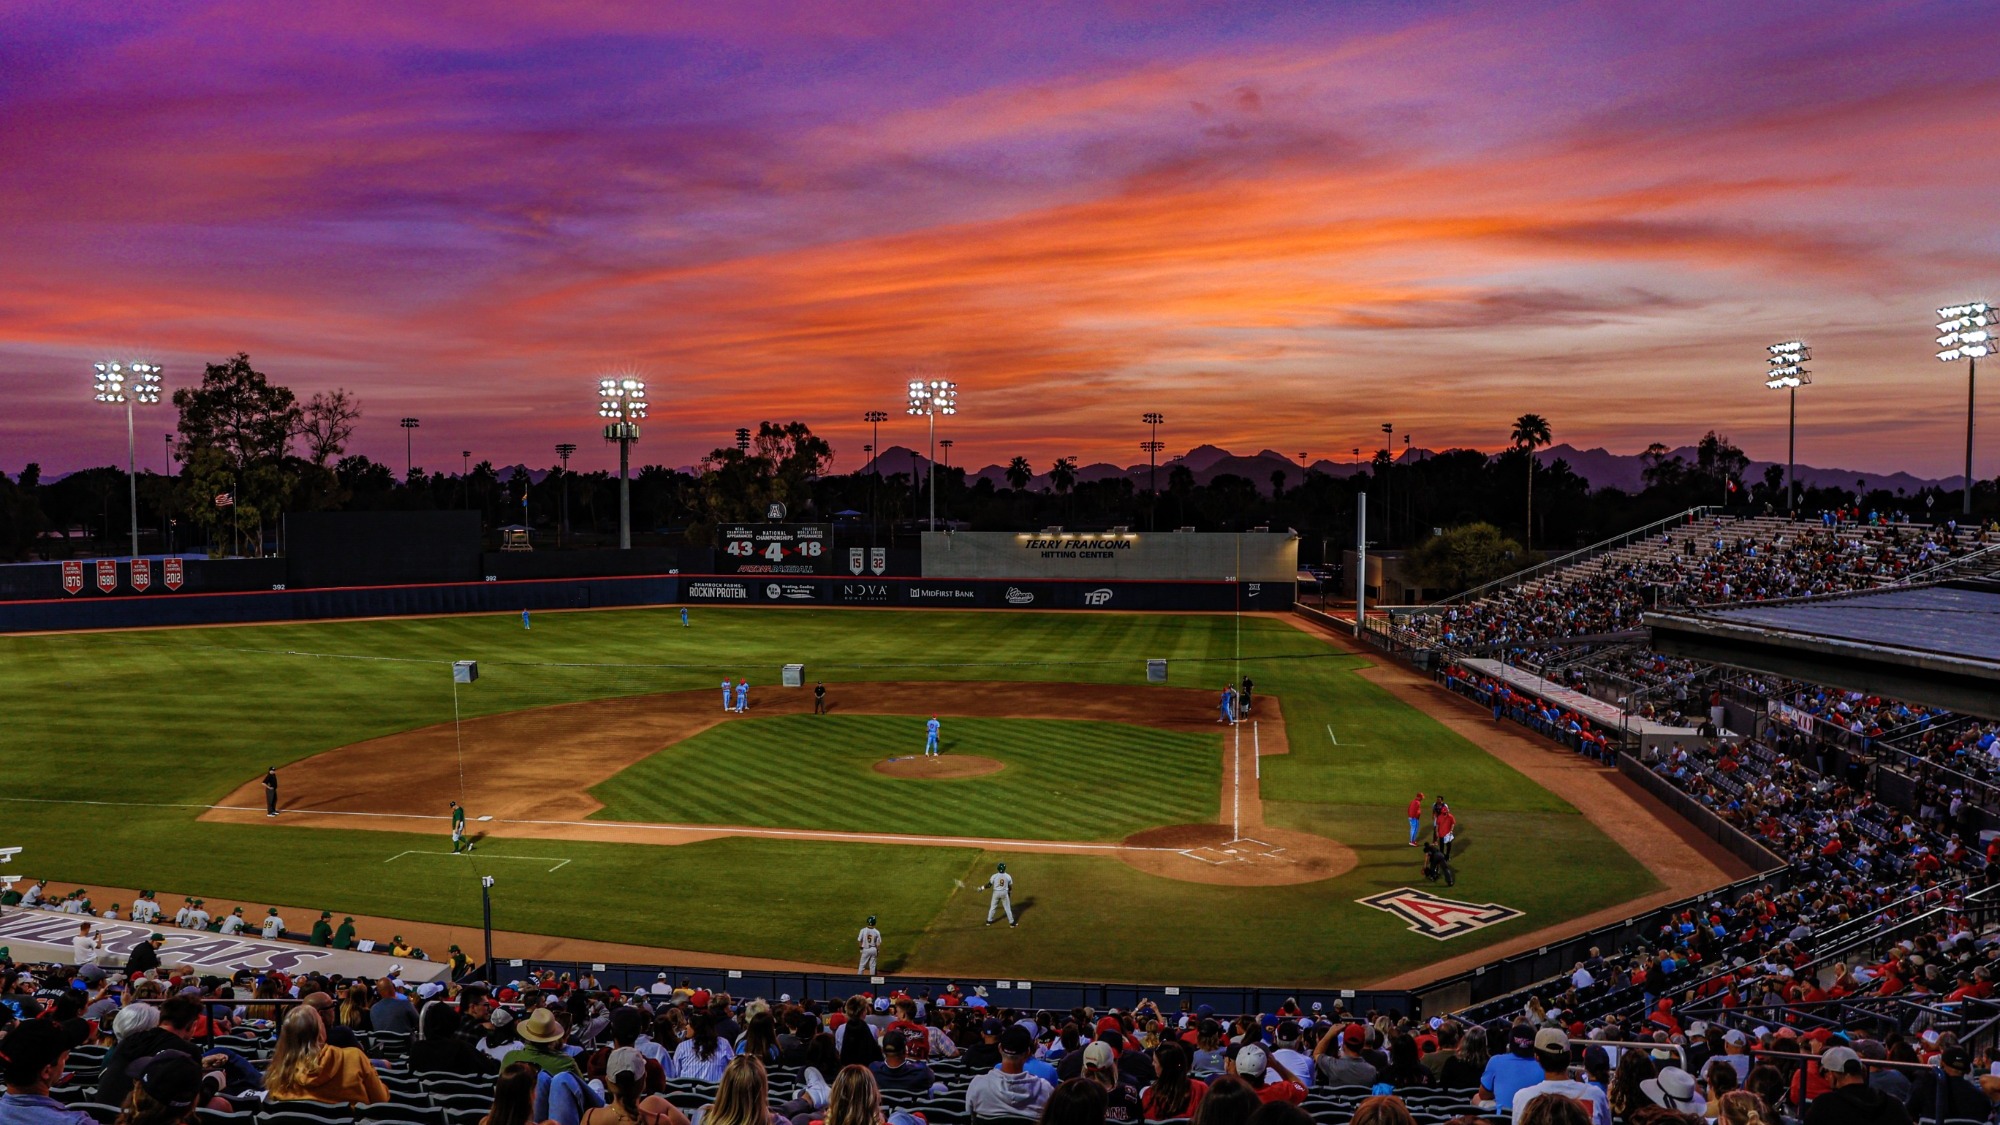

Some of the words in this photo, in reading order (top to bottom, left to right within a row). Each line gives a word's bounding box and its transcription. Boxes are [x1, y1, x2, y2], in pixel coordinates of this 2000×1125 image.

[727, 541, 753, 556] 43
[798, 541, 822, 557] 18
[1025, 539, 1063, 549] TERRY
[1064, 539, 1131, 550] FRANCONA
[765, 542, 784, 562] 4
[1041, 551, 1077, 559] HITTING
[1079, 551, 1114, 559] CENTER
[737, 564, 771, 573] ARIZONA
[771, 565, 814, 573] BASEBALL
[852, 557, 861, 569] 15
[873, 557, 884, 569] 32
[65, 576, 81, 587] 1976
[100, 574, 115, 586] 1980
[133, 573, 148, 585] 1986
[166, 572, 181, 584] 2012
[844, 584, 888, 596] NOVA
[1084, 592, 1109, 605] TEP
[1353, 886, 1526, 941] A
[263, 920, 274, 929] 39
